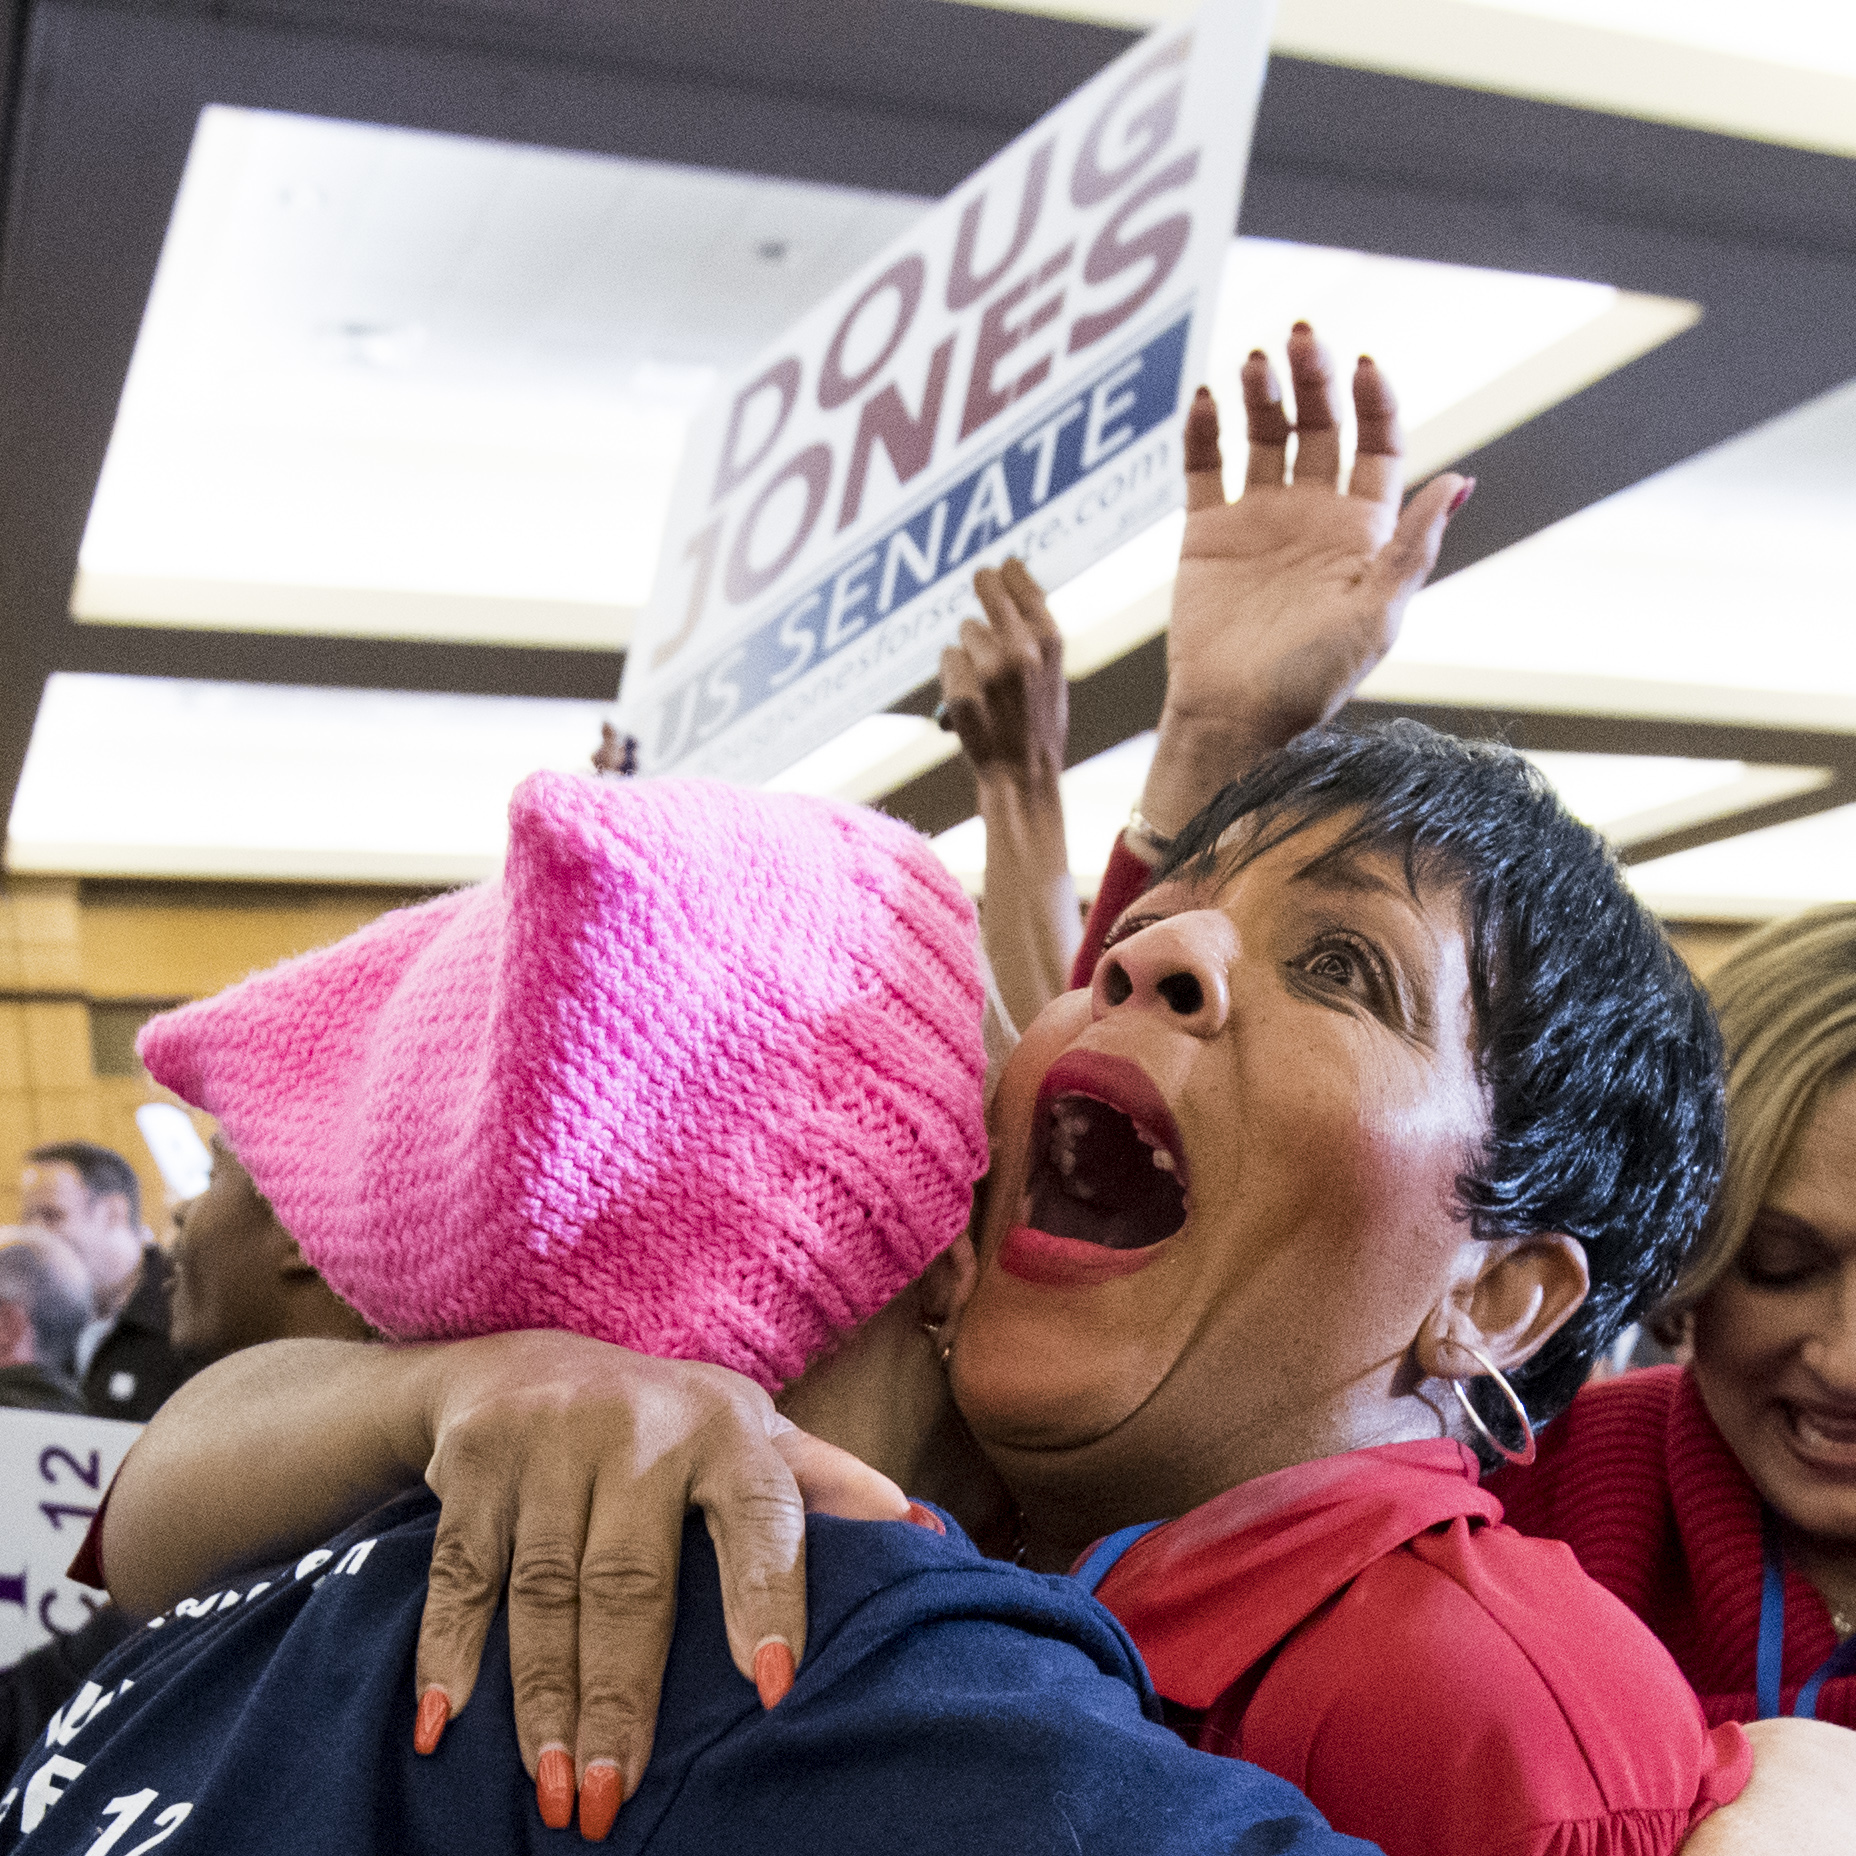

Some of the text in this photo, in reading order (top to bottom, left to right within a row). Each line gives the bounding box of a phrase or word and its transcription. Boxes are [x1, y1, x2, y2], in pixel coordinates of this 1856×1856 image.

[647, 147, 1203, 673] JONES
[708, 30, 1196, 508] DOUG
[649, 647, 747, 769] US
[768, 350, 1145, 686] SENATE
[39, 1445, 99, 1530] 12
